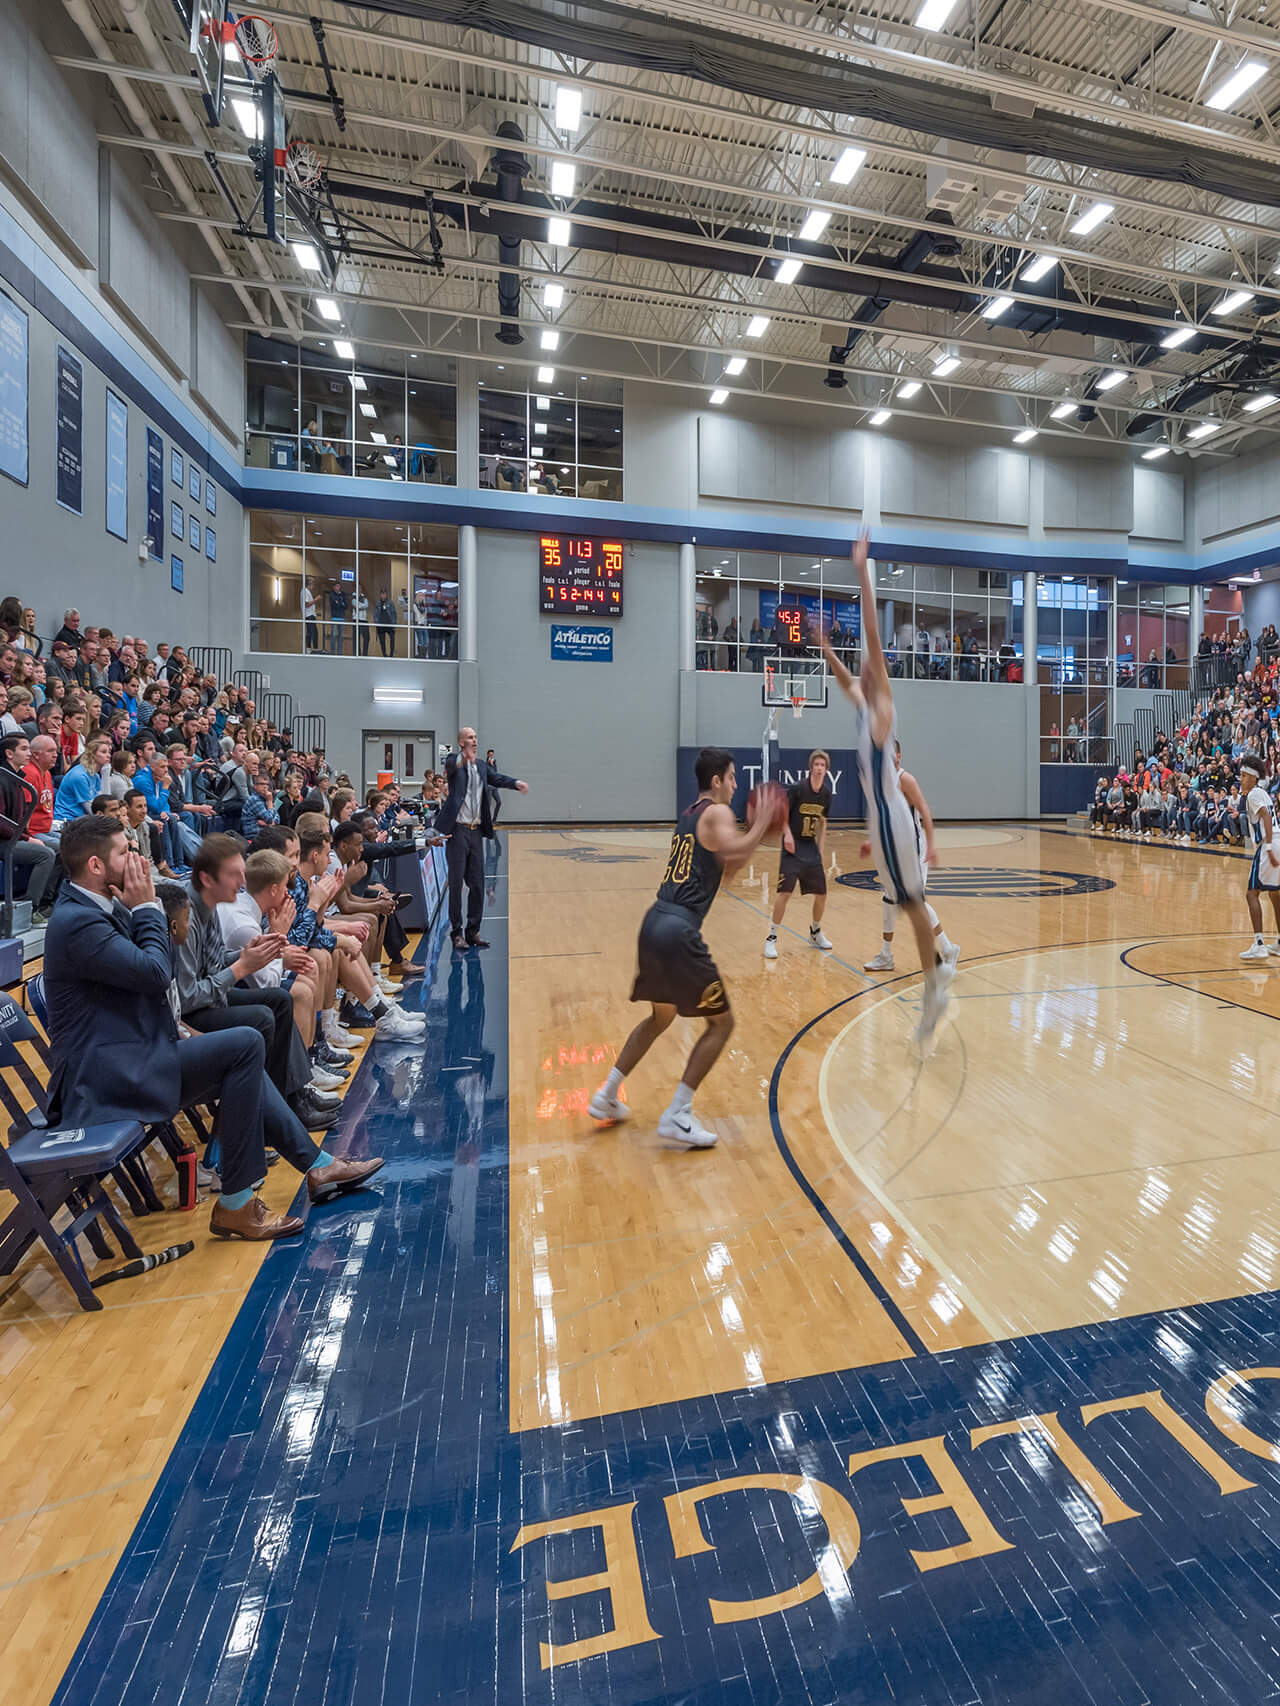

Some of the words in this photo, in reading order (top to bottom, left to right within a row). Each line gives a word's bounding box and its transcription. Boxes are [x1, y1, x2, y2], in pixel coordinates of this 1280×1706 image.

[544, 548, 561, 566] 35
[605, 552, 622, 570] 20
[547, 586, 554, 599] 7
[596, 590, 605, 602] 4
[611, 591, 620, 603] 4
[788, 625, 801, 642] 15
